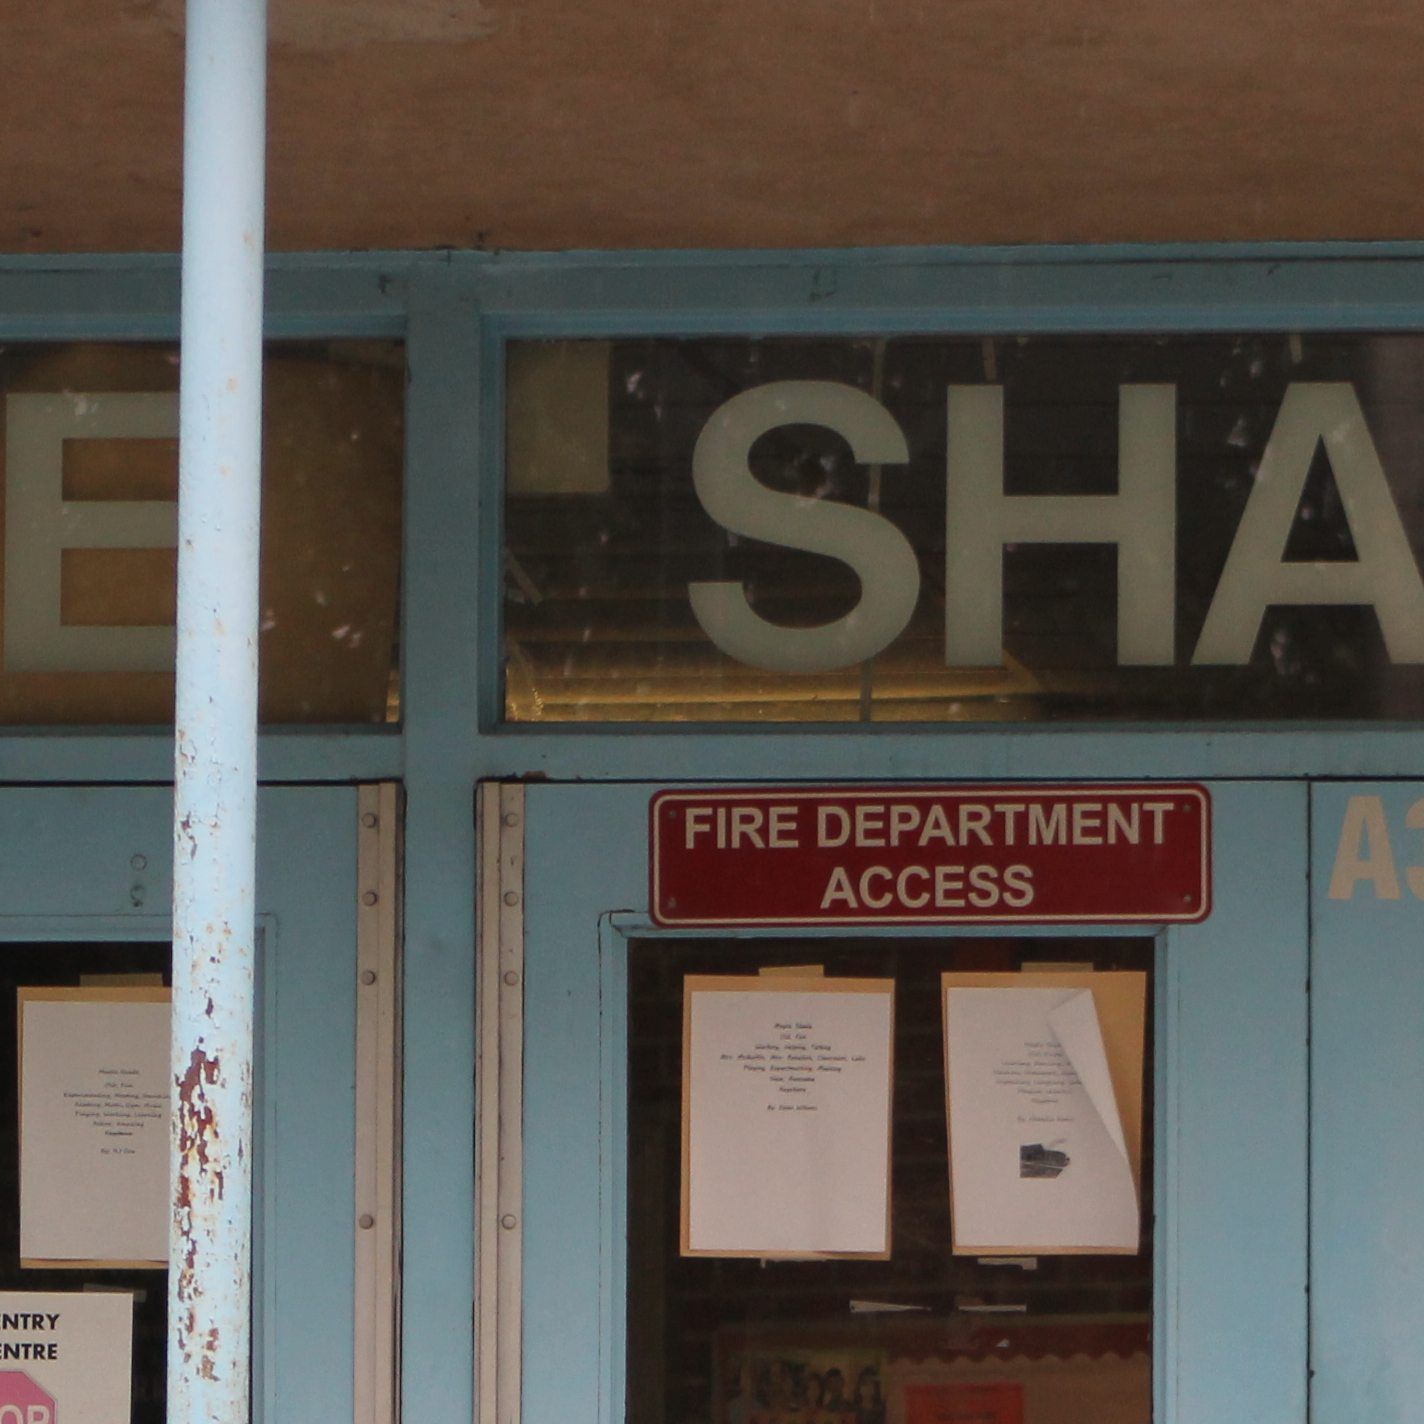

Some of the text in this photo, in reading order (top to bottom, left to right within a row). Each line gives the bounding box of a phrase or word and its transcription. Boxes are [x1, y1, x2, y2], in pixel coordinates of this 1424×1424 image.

[684, 802, 1175, 848] FIRE DEPARTMENT
[820, 865, 1036, 909] ACCESS
